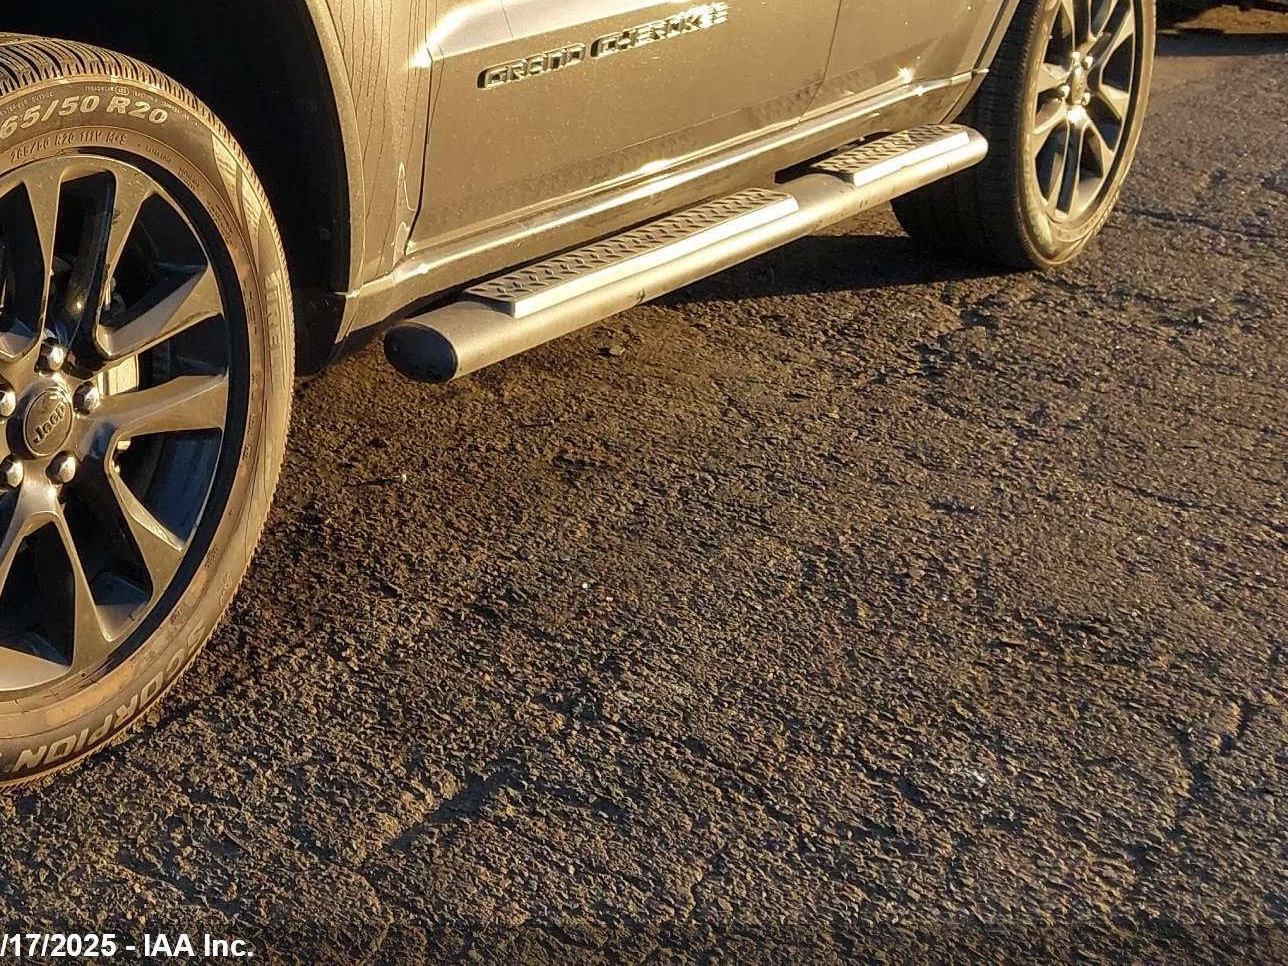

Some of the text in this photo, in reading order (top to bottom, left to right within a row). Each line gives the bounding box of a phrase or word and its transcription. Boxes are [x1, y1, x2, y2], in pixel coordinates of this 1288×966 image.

[477, 43, 587, 91] GRAND
[106, 96, 168, 124] R20
[32, 400, 66, 445] Jeep
